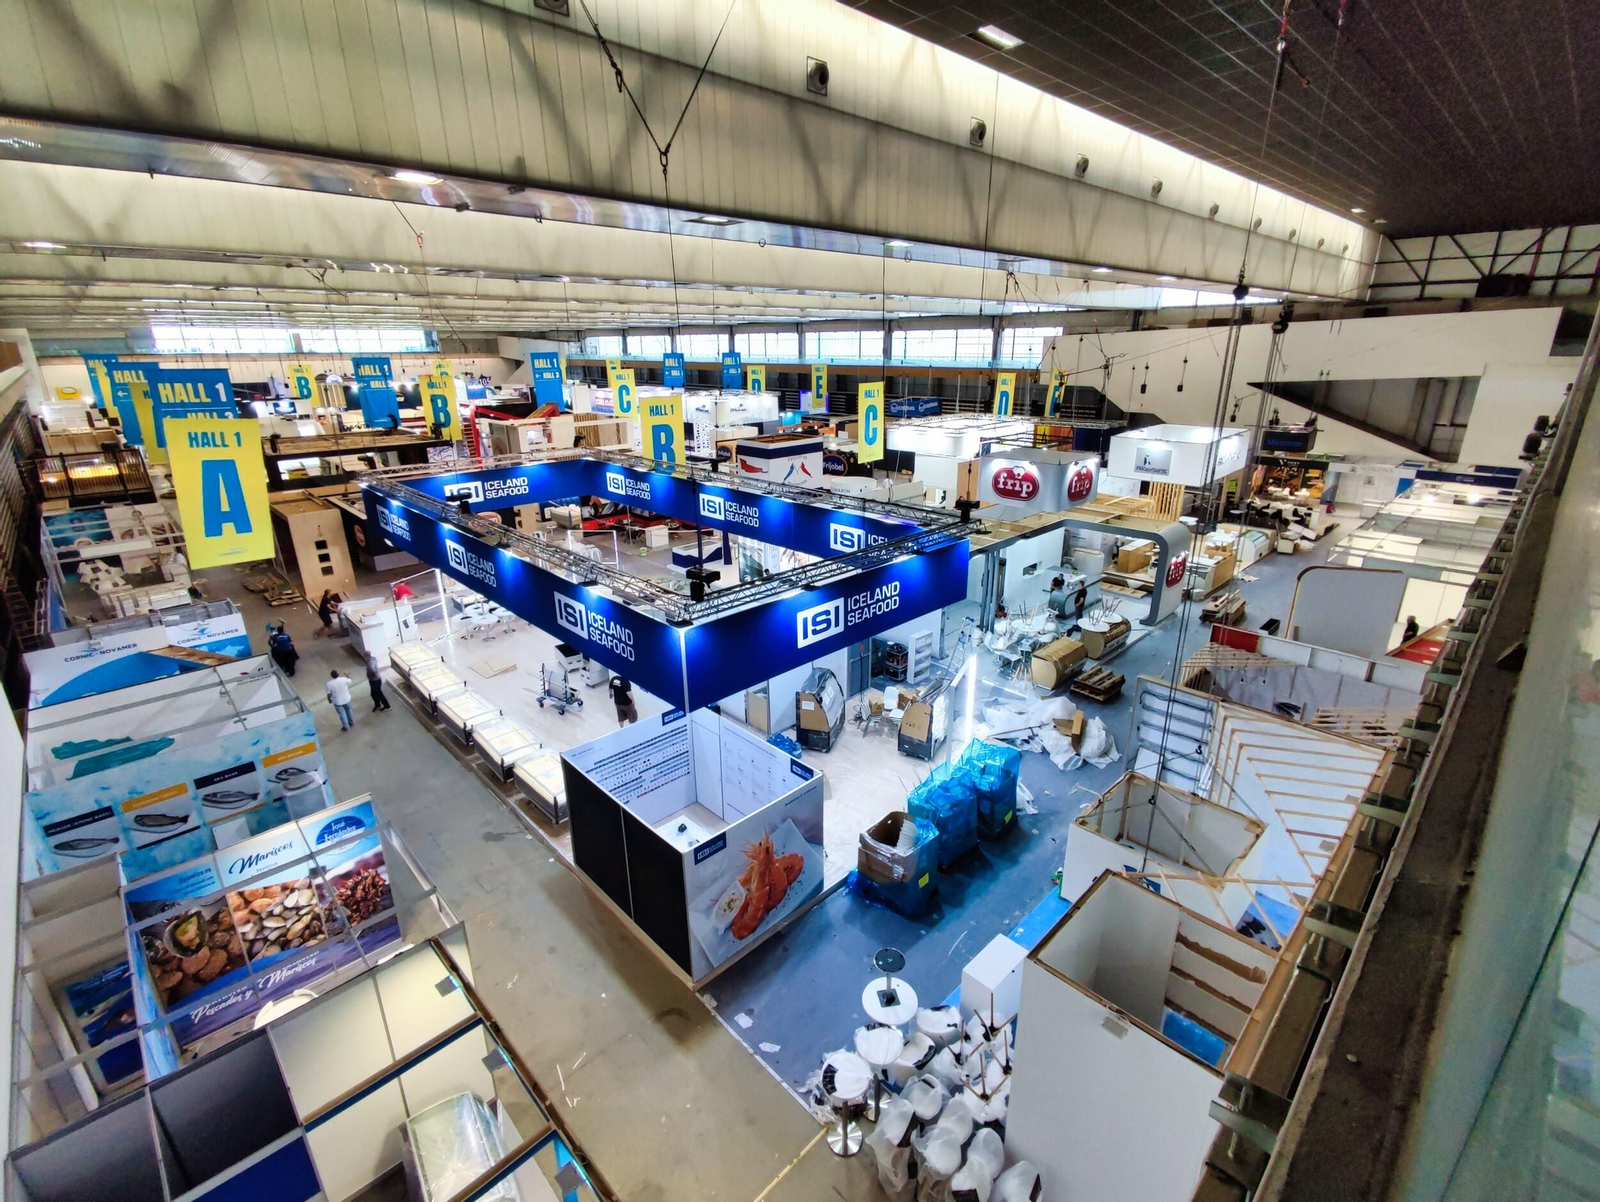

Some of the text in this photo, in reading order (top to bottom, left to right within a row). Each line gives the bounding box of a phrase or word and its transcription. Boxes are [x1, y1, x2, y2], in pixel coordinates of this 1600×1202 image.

[534, 358, 558, 368] HALL 1
[724, 357, 735, 365] HALL
[112, 370, 148, 383] HALL
[296, 376, 312, 399] B
[816, 375, 822, 399] E
[157, 382, 211, 403] HALL
[215, 382, 227, 402] 1
[618, 384, 632, 413] C
[864, 390, 875, 399] HALL
[430, 394, 451, 428] B
[649, 404, 674, 417] HALL 1
[864, 404, 878, 446] C
[187, 431, 242, 448] HALL 1
[652, 423, 676, 476] B
[823, 462, 844, 471] Frijobel
[484, 477, 528, 491] ICELAND
[486, 485, 529, 499] SEAFOOD
[608, 476, 650, 493] ISI ICELAND
[626, 486, 650, 500] SEAFOOD
[997, 472, 1033, 497] frip
[1071, 476, 1090, 495] frip
[201, 459, 252, 538] A
[702, 497, 759, 520] ISI ICELAND
[378, 508, 410, 532] ISI ICELAND
[726, 513, 759, 528] SEAFOOD
[392, 523, 412, 542] SEAFOOD
[832, 528, 863, 550] ISI
[448, 542, 495, 575] ISI ICELAND
[469, 563, 497, 588] SEAFOOD
[556, 598, 633, 646] ISI ICELAND
[801, 581, 900, 642] ISI ICELAND
[847, 596, 900, 626] SEAFOOD
[64, 653, 94, 663] CORNIC
[100, 643, 138, 655] NOVAMER
[589, 626, 635, 661] SEAFOOD
[331, 821, 345, 831] José
[228, 841, 293, 874] Mariscos
[190, 994, 242, 1024] Pescados
[245, 989, 254, 1000] y
[257, 958, 317, 988] Mariscos
